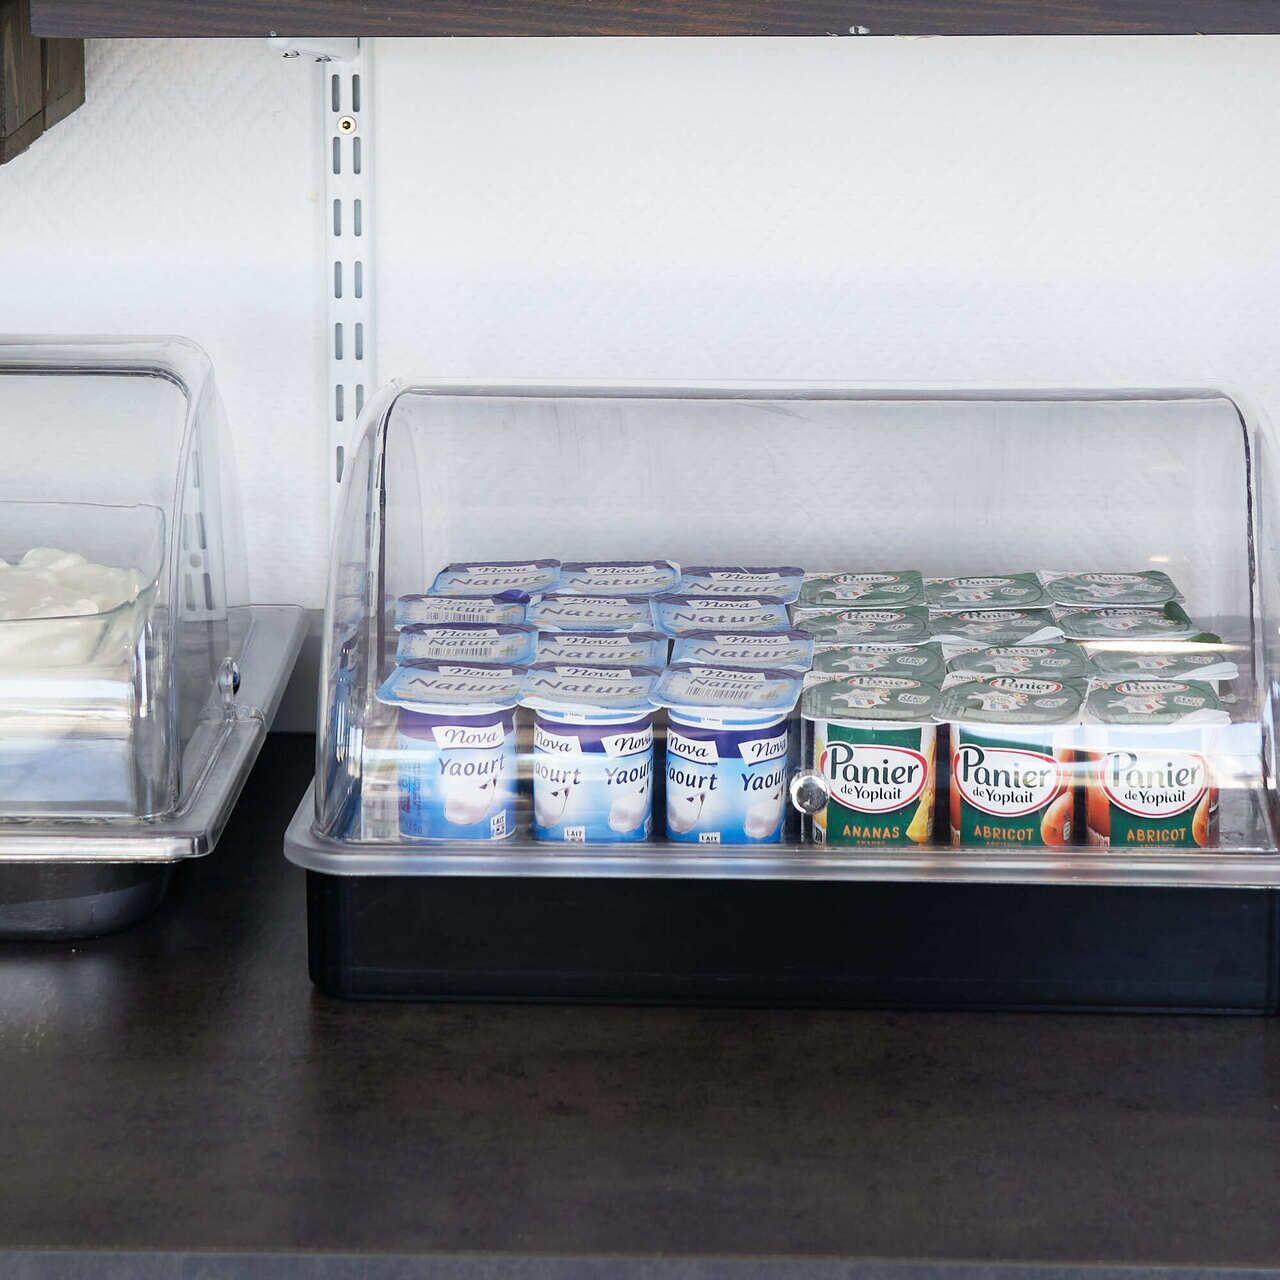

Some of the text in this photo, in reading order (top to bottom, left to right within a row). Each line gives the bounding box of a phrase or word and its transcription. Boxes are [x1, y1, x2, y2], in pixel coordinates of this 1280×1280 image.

[448, 574, 547, 585] Nature
[570, 574, 668, 585] Nature
[688, 582, 789, 593] Nature
[699, 600, 752, 608] Nova
[539, 607, 642, 619] Nature
[674, 612, 775, 623] Nature
[428, 638, 500, 647] Nature
[539, 647, 644, 659] Nature
[694, 647, 800, 658] Nature
[567, 668, 621, 678] Nova
[408, 677, 518, 692] Nature
[535, 678, 644, 694] Nature
[690, 678, 764, 690] Nature
[444, 729, 498, 744] Nova
[438, 753, 505, 776] Yaourt
[827, 742, 919, 784] Panier
[959, 745, 1051, 788] Panier
[841, 784, 902, 803] de Yoplait
[972, 788, 1033, 806] de Yoplait
[1124, 790, 1138, 800] de
[842, 824, 900, 839] ANANAS
[974, 825, 1034, 841] ABRICOT
[1126, 828, 1187, 842] ABRICOT
